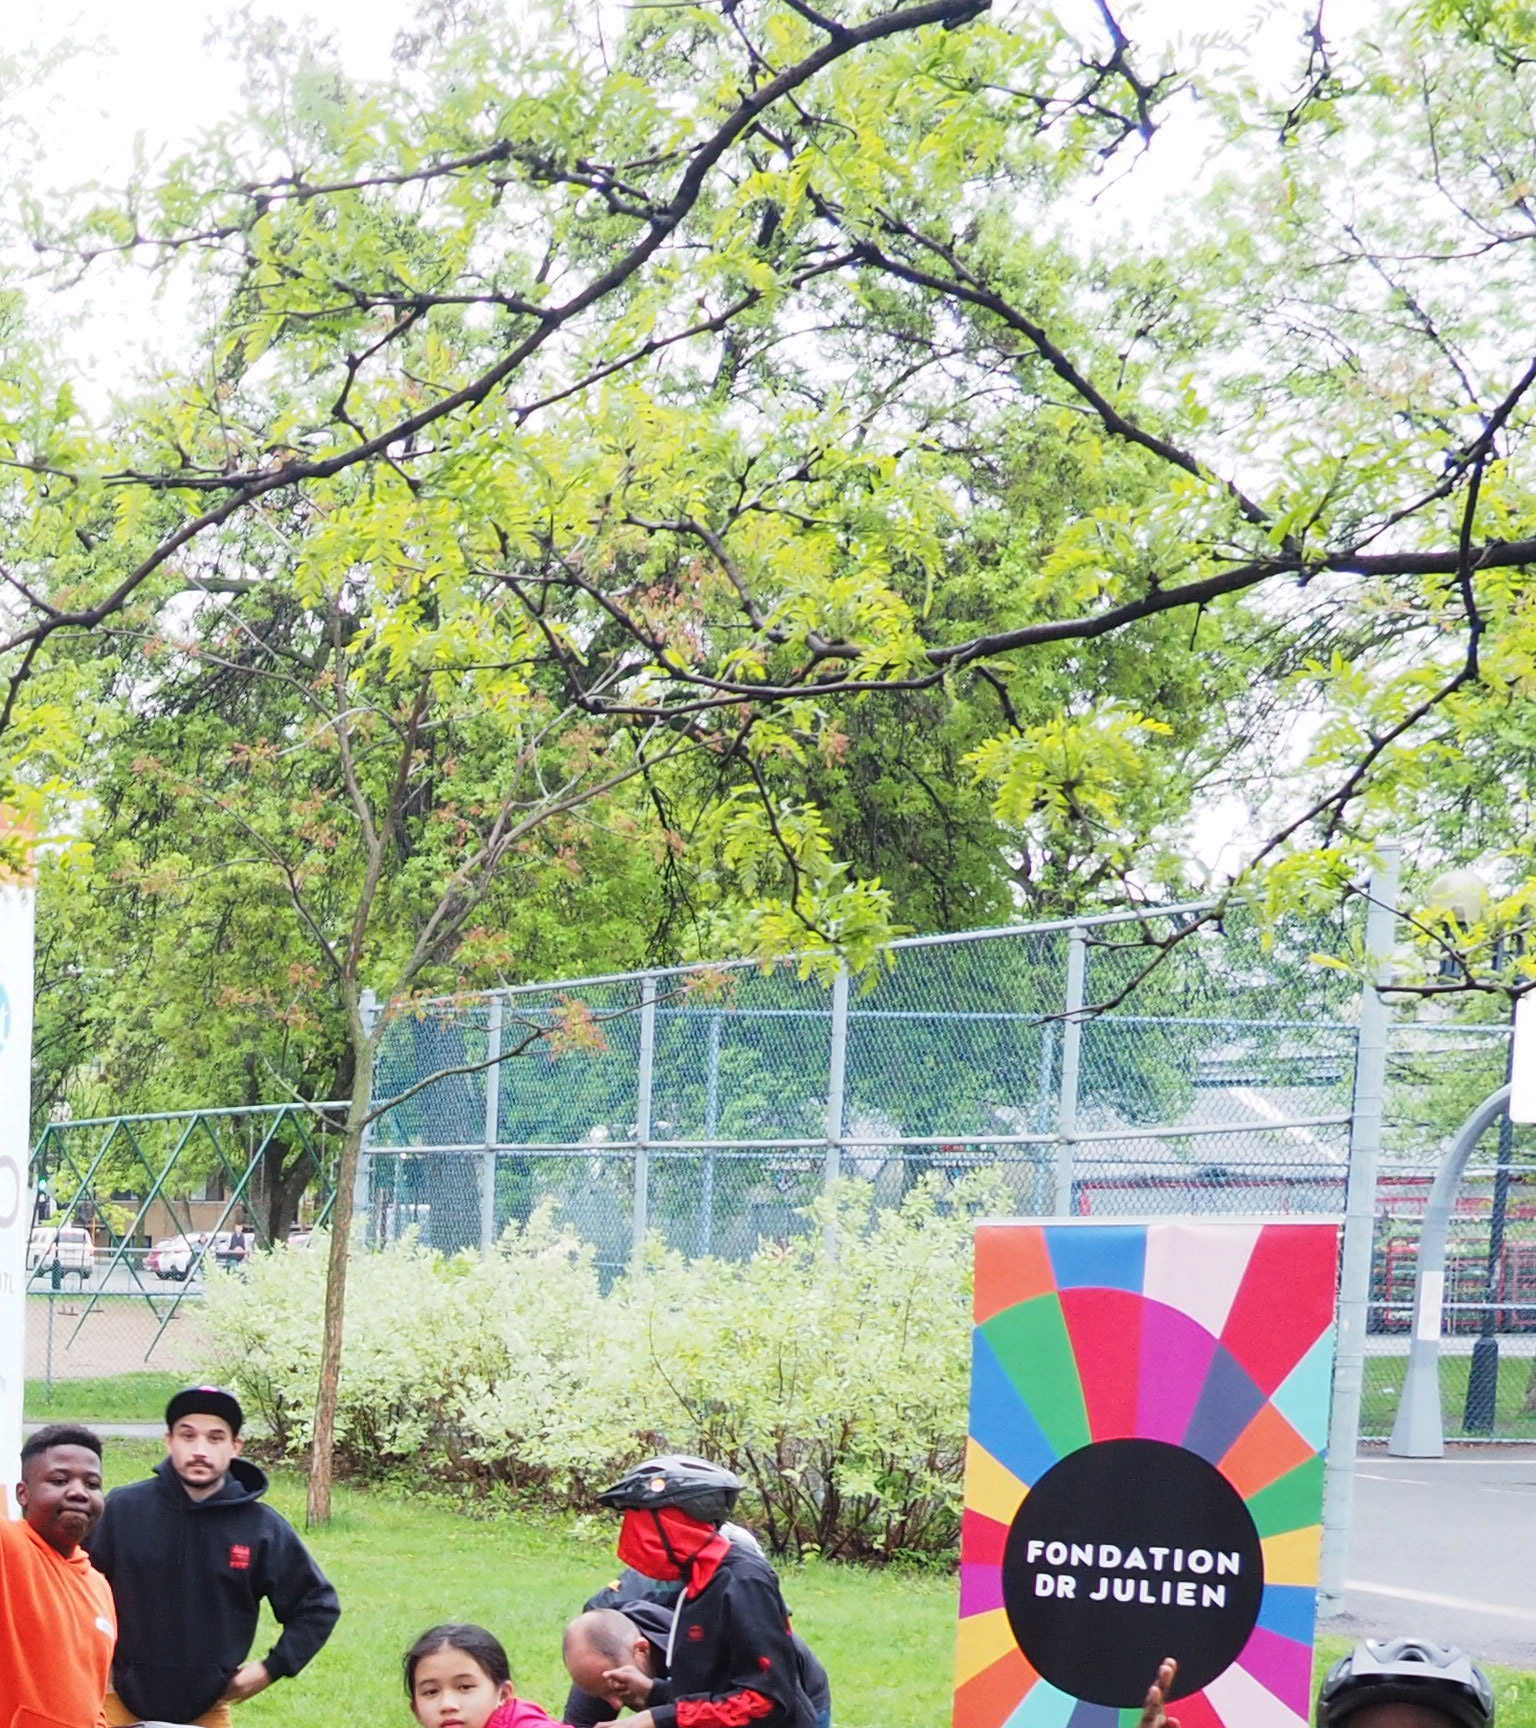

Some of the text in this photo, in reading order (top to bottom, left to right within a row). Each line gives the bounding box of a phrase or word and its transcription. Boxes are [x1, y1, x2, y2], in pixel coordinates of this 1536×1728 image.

[1026, 1540, 1240, 1575] FONDATION
[1034, 1573, 1226, 1608] DR JULIEN
